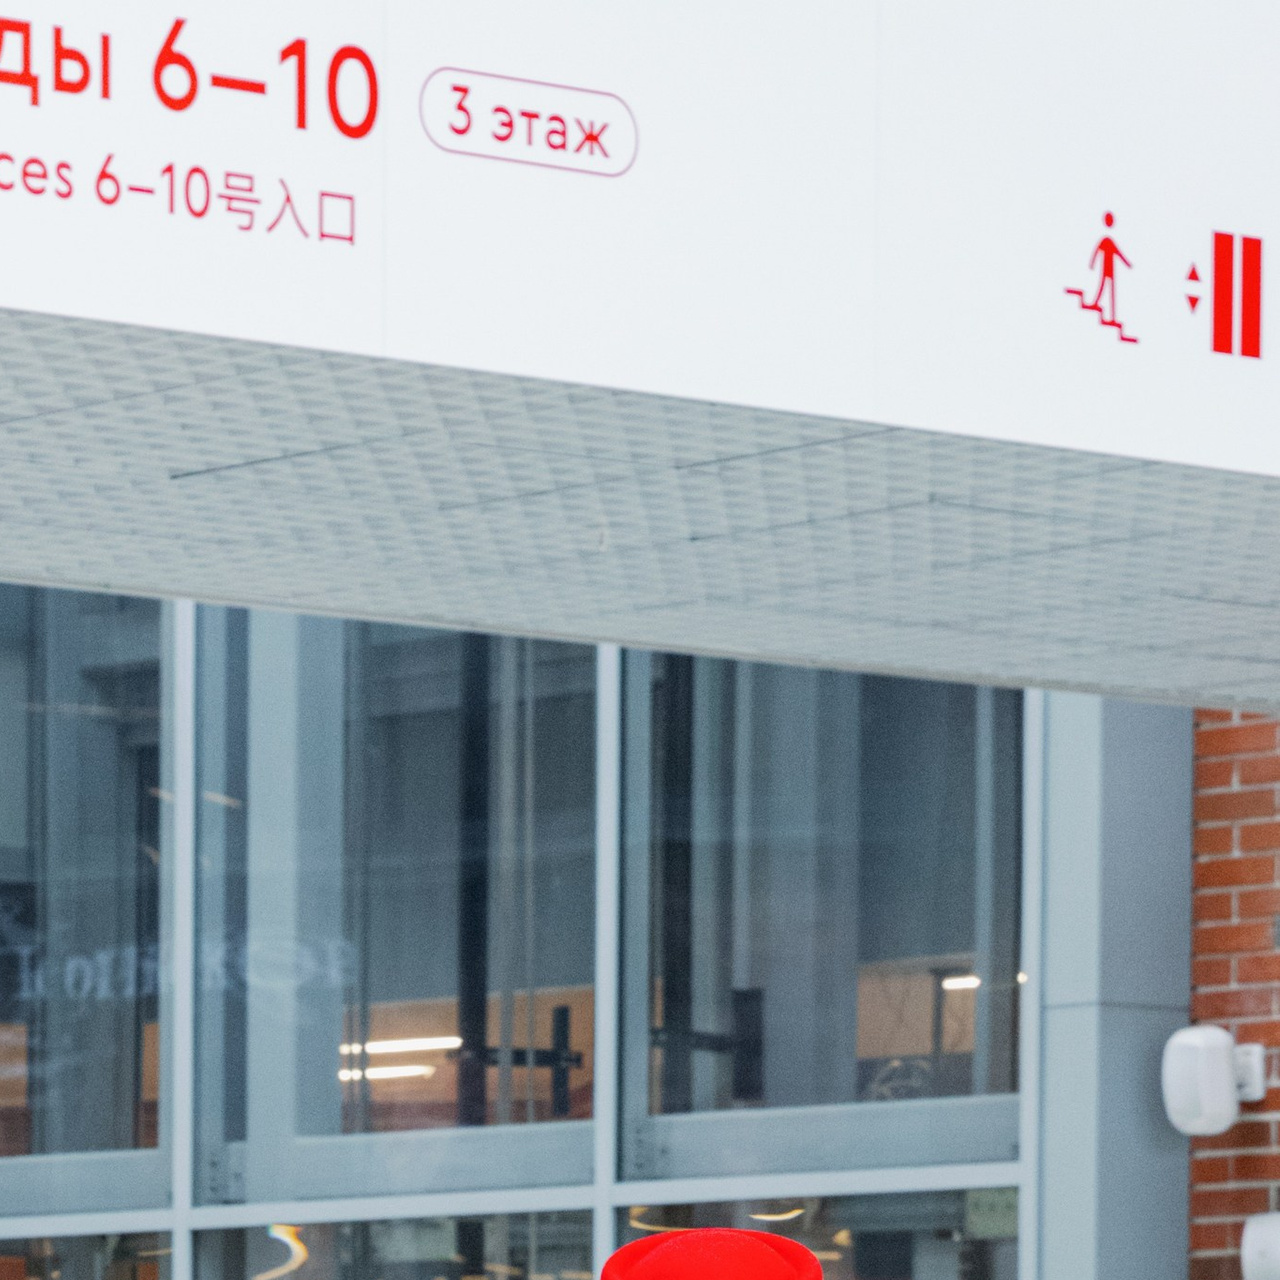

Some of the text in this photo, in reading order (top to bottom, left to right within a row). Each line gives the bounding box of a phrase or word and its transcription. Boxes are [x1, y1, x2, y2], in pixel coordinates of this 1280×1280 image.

[150, 17, 381, 142] 6–10
[449, 84, 611, 160] 3 этаж
